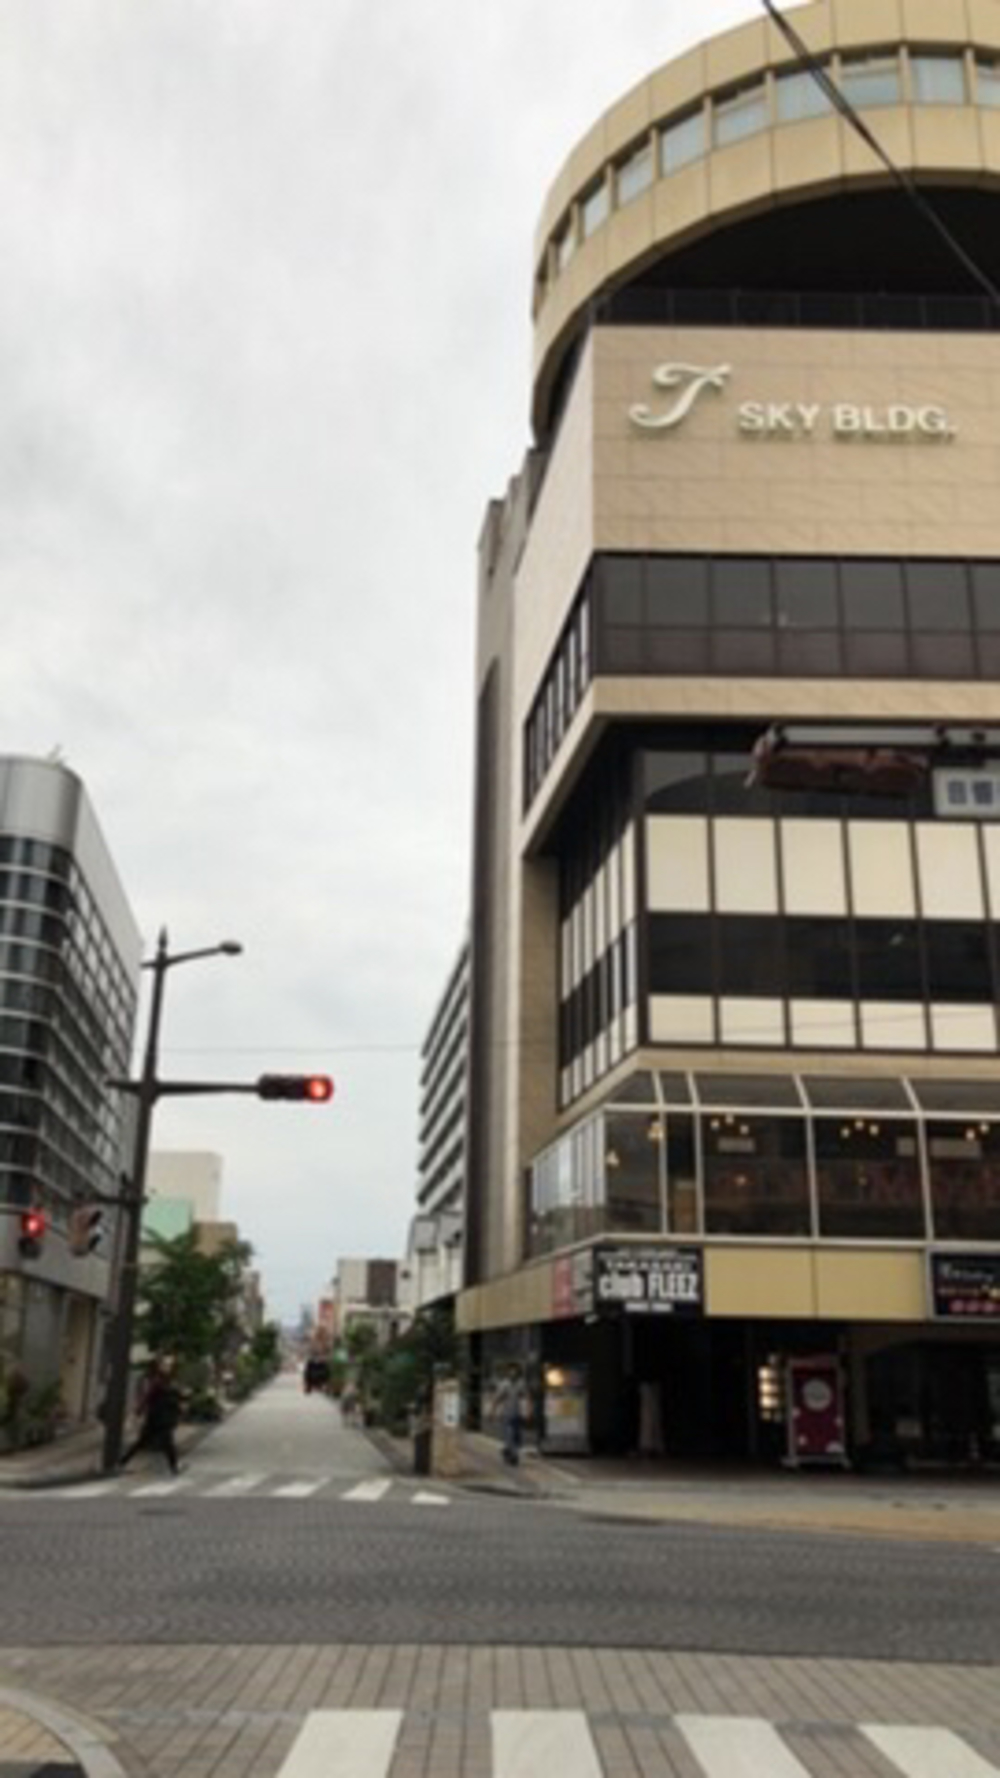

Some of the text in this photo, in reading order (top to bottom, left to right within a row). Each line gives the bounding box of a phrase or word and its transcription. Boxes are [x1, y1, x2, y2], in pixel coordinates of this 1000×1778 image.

[738, 402, 820, 431] SKY
[834, 403, 957, 435] BLDG.
[599, 1271, 645, 1299] club
[648, 1273, 699, 1301] FLEEZ
